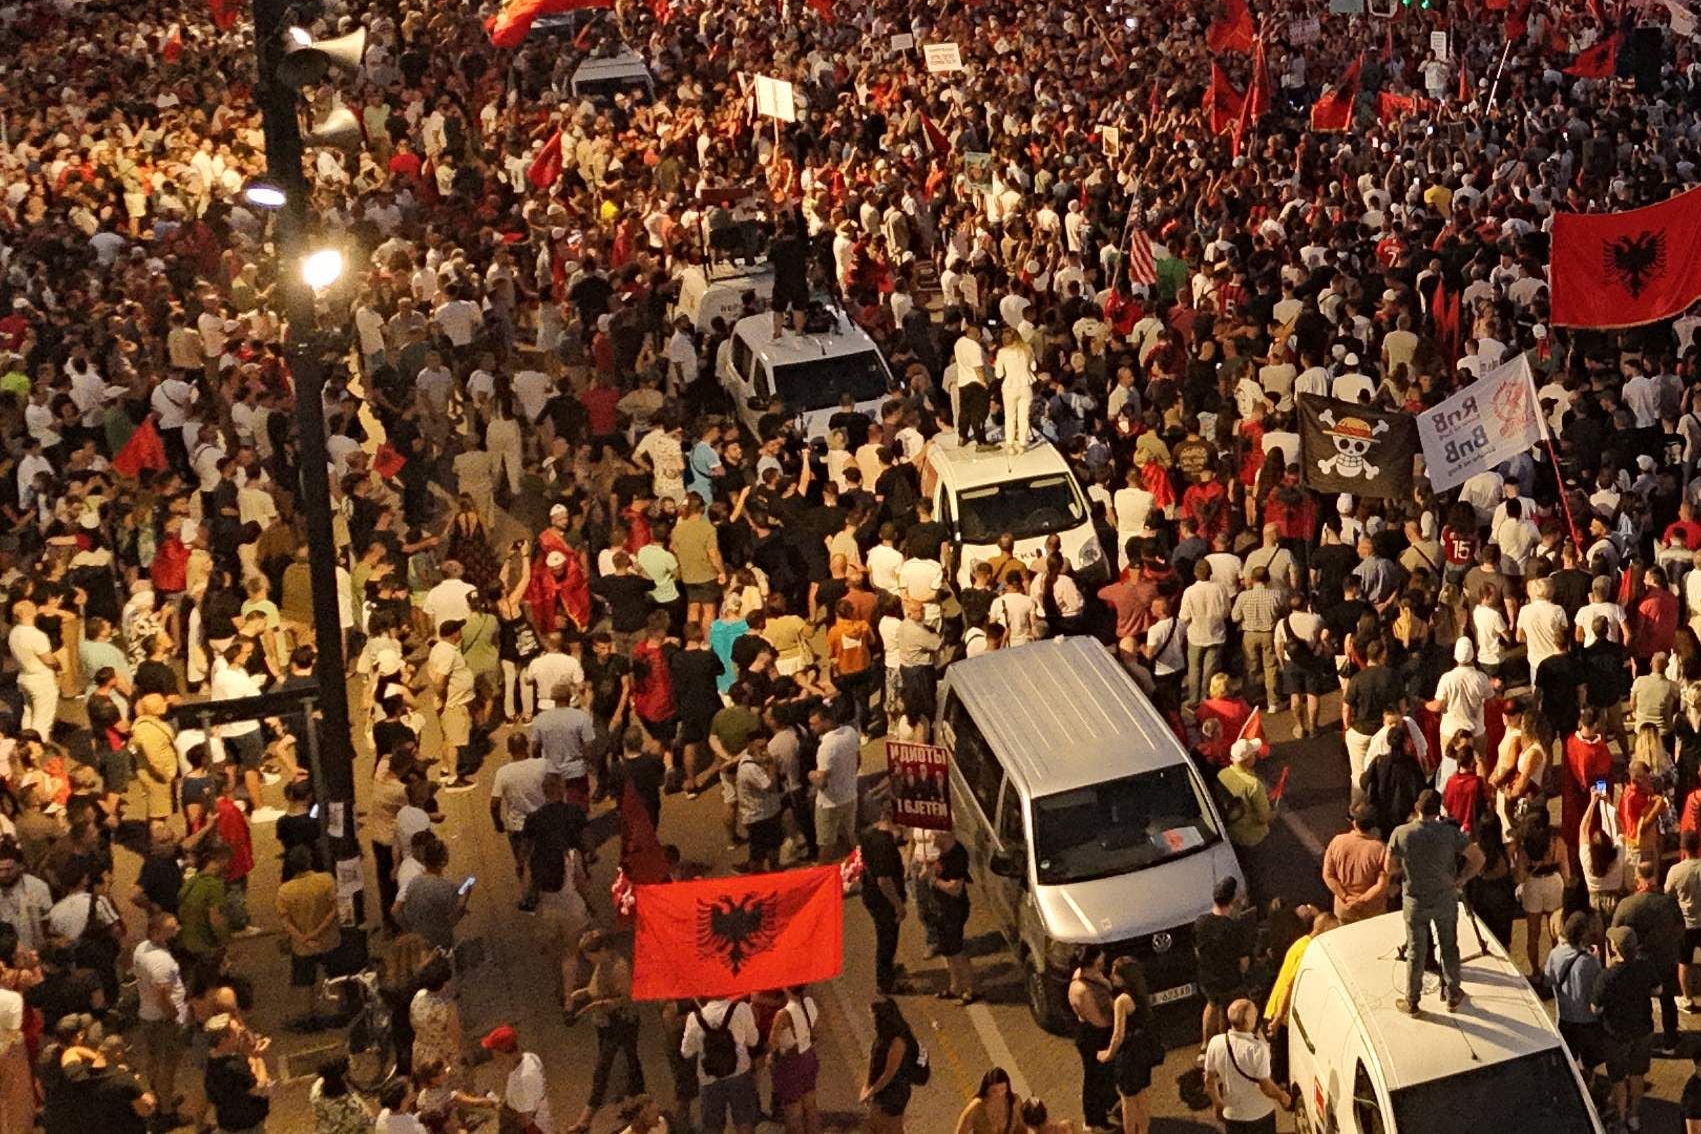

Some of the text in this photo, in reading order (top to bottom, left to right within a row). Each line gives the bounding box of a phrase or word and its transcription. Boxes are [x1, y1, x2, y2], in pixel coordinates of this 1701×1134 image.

[1387, 251, 1397, 268] 7
[1452, 539, 1471, 560] 15
[889, 744, 946, 765] ИДИОТЫ
